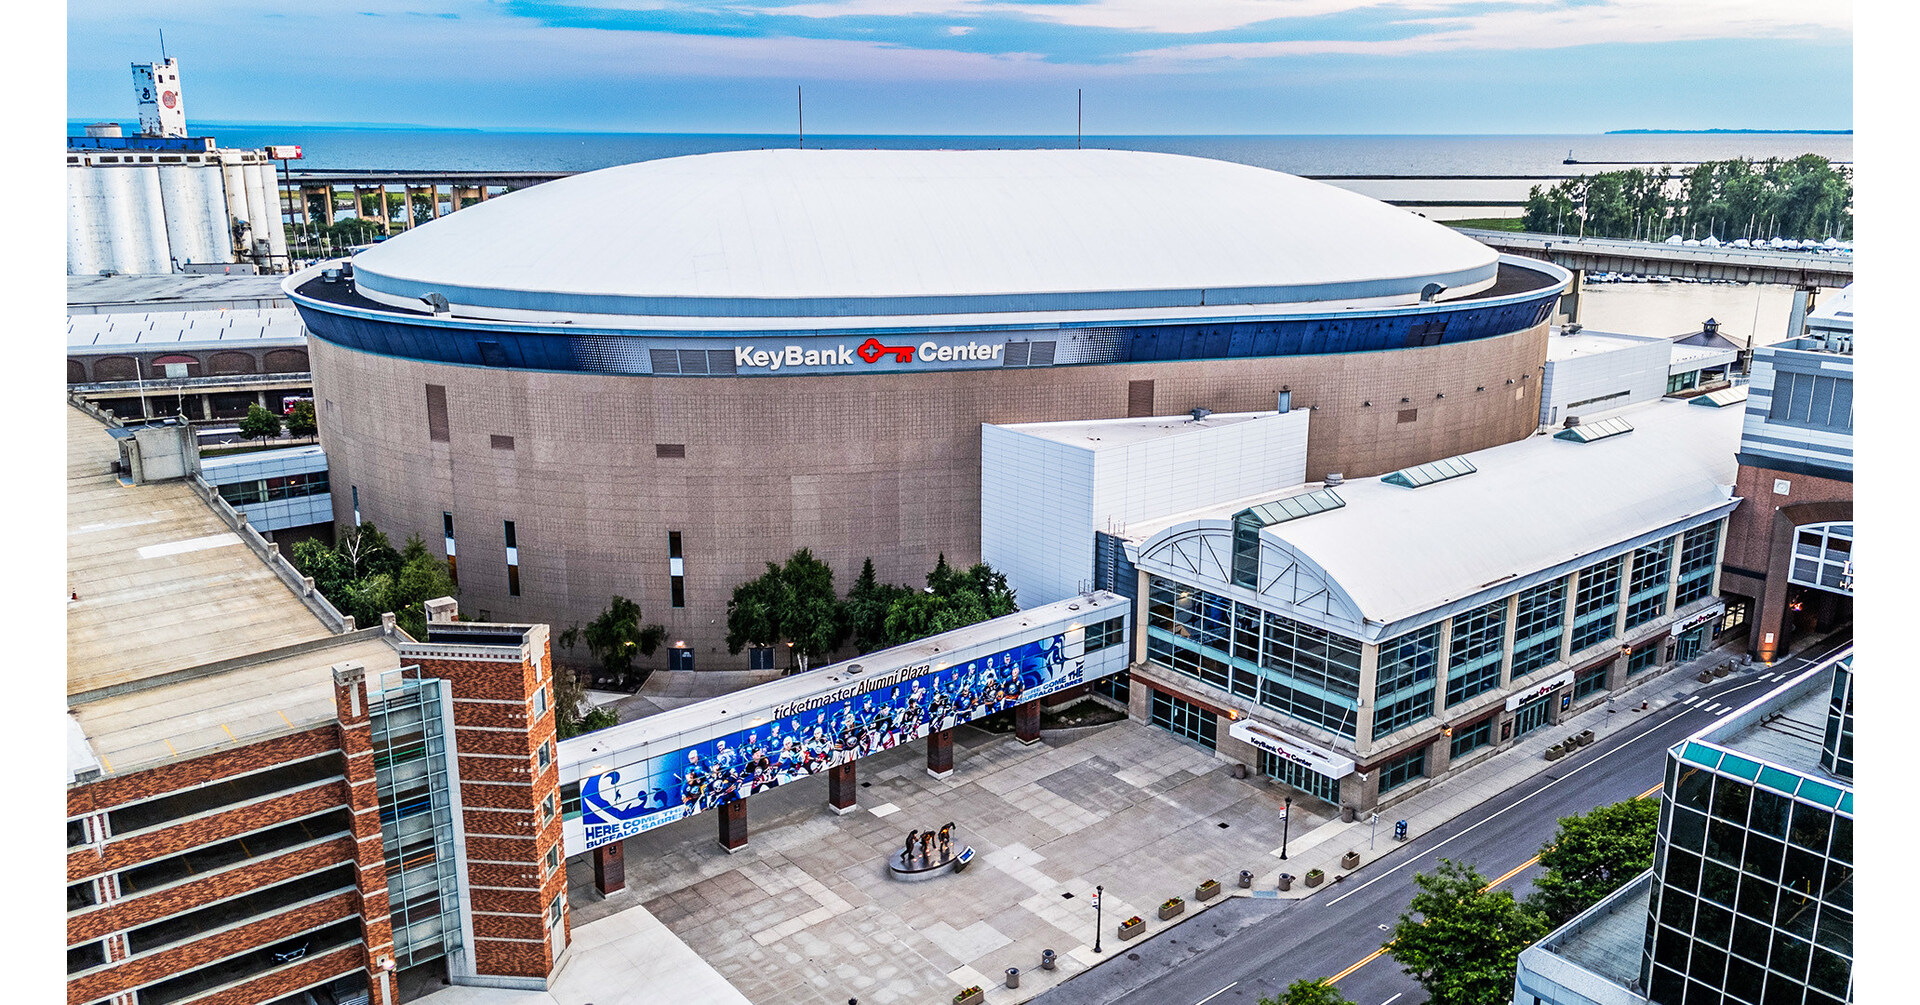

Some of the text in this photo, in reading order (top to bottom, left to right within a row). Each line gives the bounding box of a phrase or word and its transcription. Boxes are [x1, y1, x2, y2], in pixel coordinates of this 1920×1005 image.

[734, 341, 1004, 371] KeyBank Center
[1068, 665, 1083, 680] THE
[774, 663, 930, 720] ticketmaster Alumni Plaza
[1251, 737, 1312, 767] KeyBank Center
[585, 823, 620, 841] HERE
[621, 814, 660, 830] COME
[586, 826, 640, 849] BUFFALO
